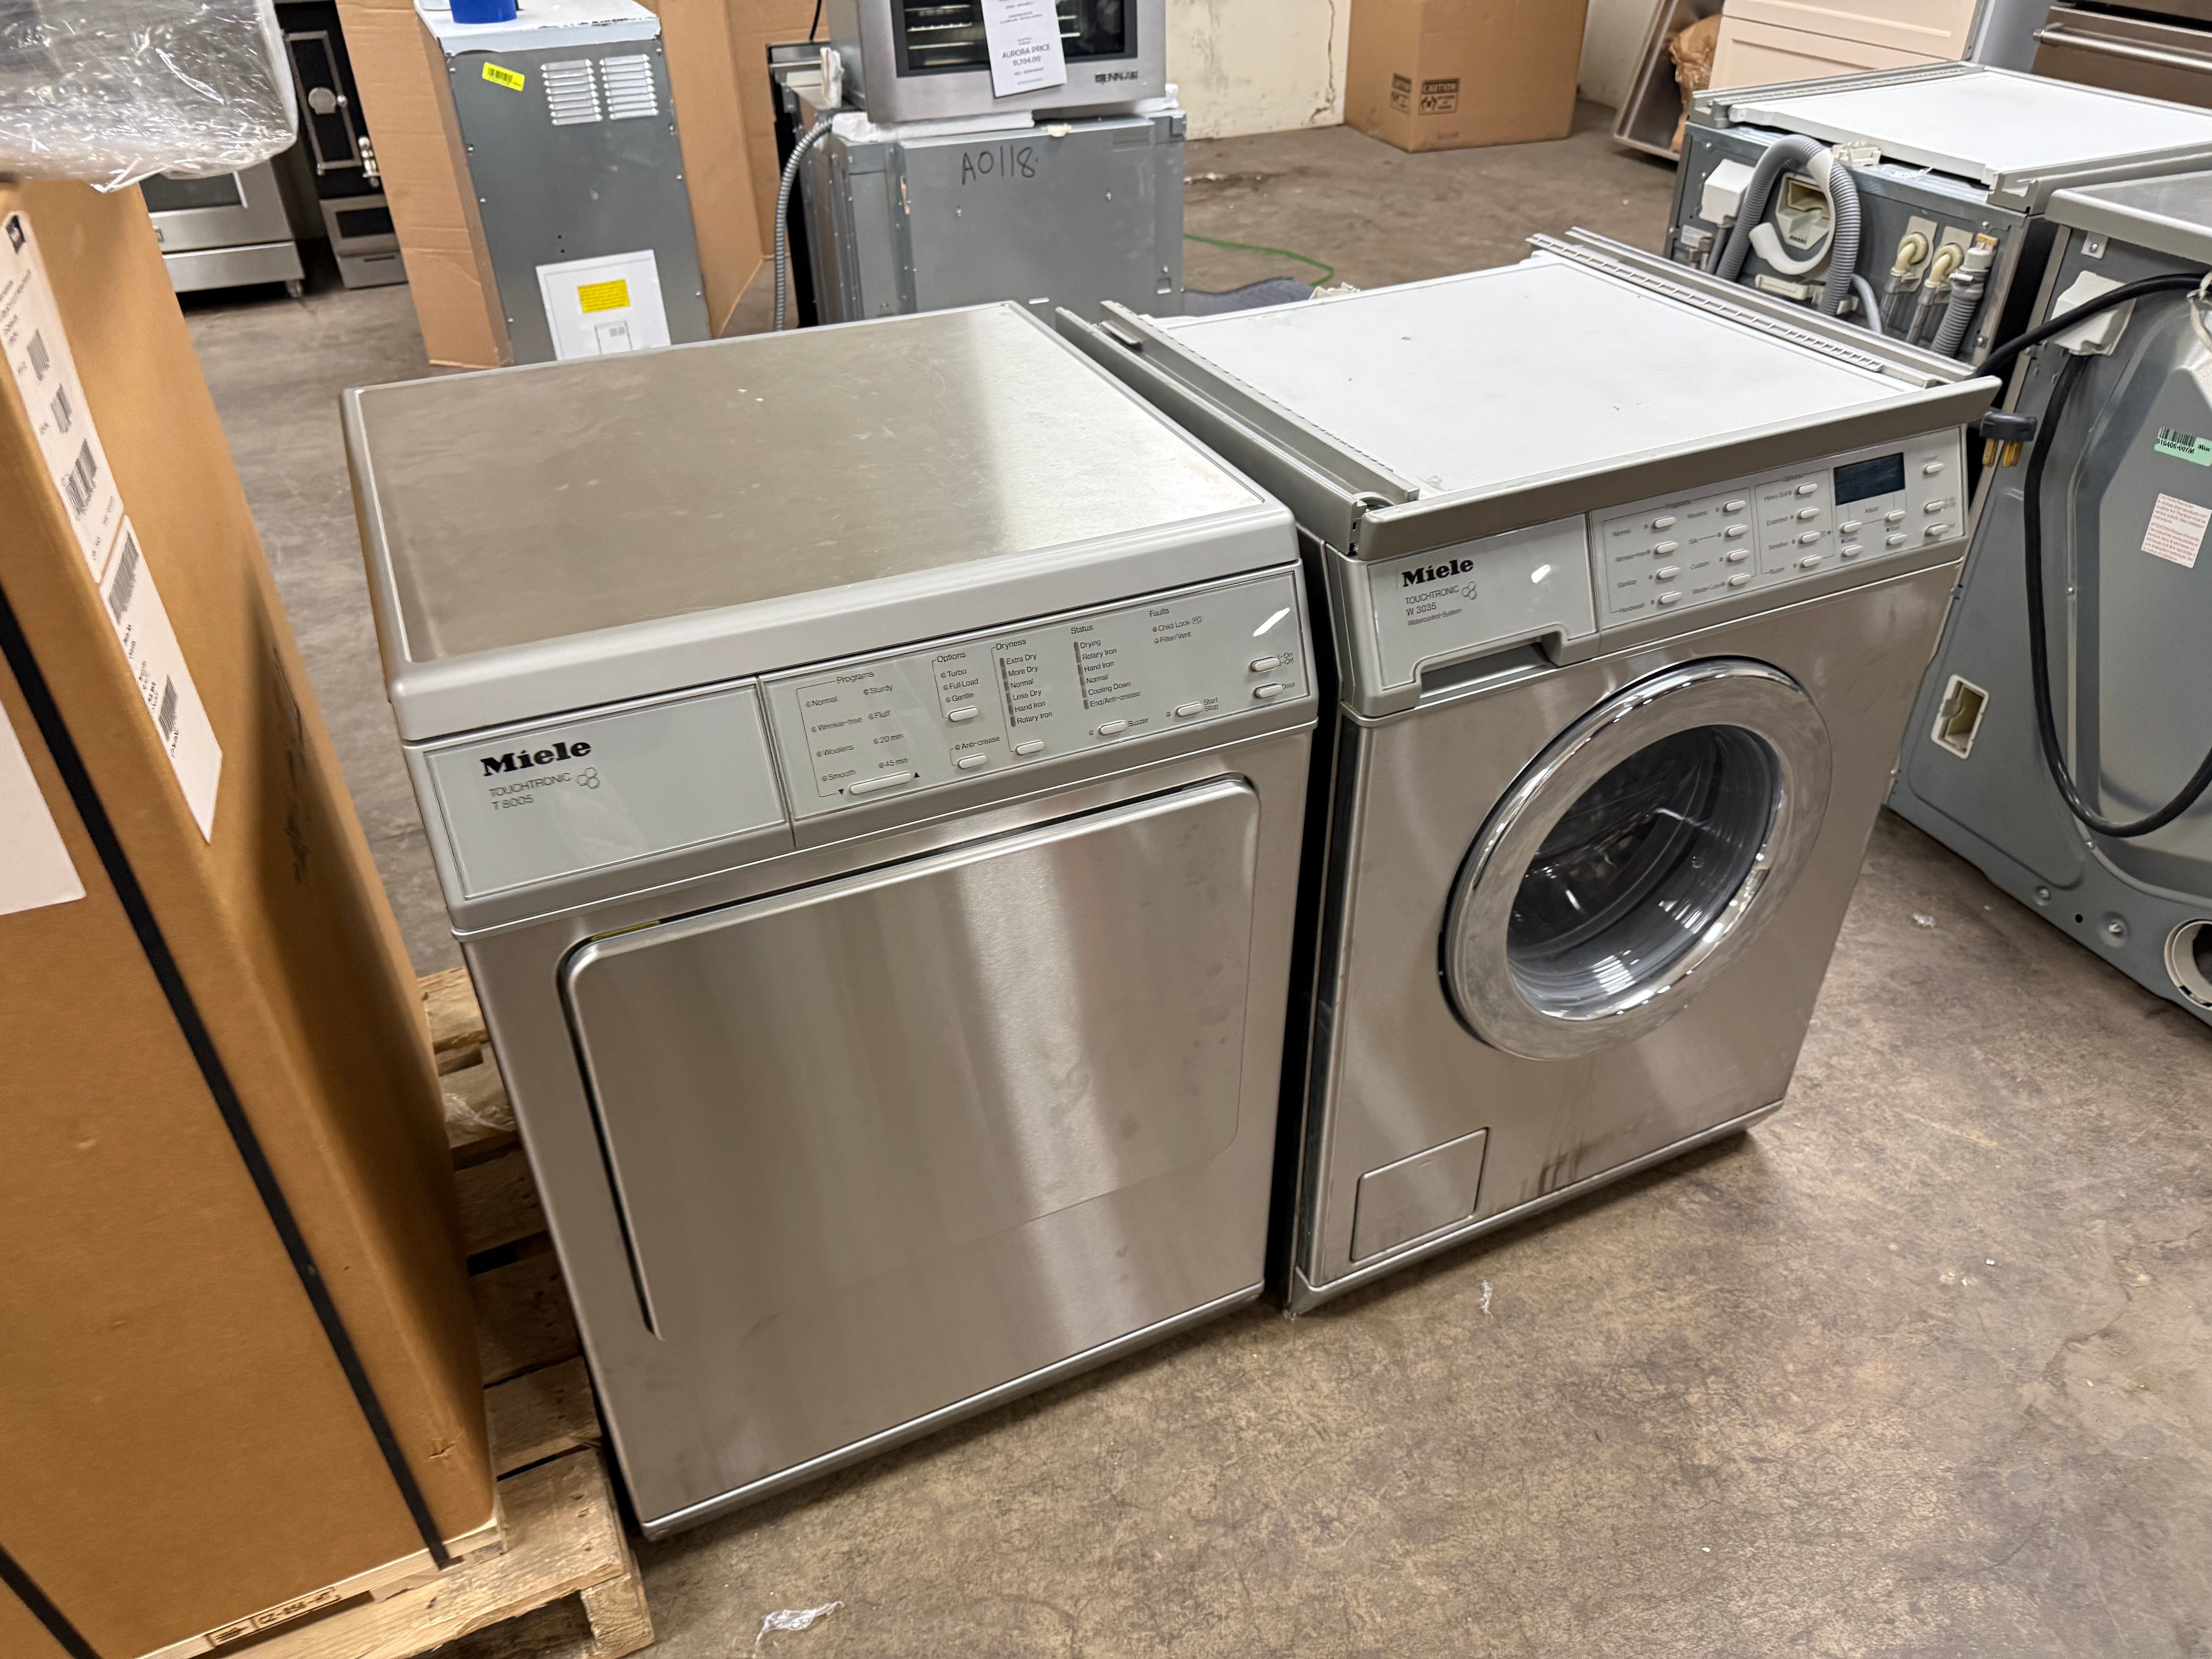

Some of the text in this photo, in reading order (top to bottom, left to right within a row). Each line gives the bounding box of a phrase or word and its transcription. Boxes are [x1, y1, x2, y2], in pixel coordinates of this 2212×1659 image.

[1031, 43, 1050, 53] PRICE
[1401, 559, 1474, 587] Miele
[1405, 586, 1459, 605] TOUCHTRONIC
[1149, 609, 1169, 617] Faults
[1416, 602, 1437, 614] 3035
[1071, 625, 1093, 634] Status
[996, 639, 1027, 651] Dryness
[1080, 640, 1101, 649] Drying
[937, 652, 966, 663] Options
[1006, 656, 1024, 665] Extra
[1082, 651, 1103, 660] Rotary
[836, 672, 874, 684] Programs
[947, 669, 967, 677] Turbo
[962, 678, 979, 687] Load
[1010, 678, 1034, 689] Normal
[1086, 674, 1108, 684] Normal
[1088, 682, 1131, 696] Cooling Down
[952, 692, 974, 702] Gentle
[1015, 704, 1032, 712] Hand
[1017, 715, 1038, 724] Rotary
[1128, 718, 1149, 727] Buzzer
[962, 736, 1000, 750] Anti-crease
[480, 742, 592, 776] Miele
[489, 773, 572, 797] TOUCHTRONIC
[491, 801, 499, 810] T
